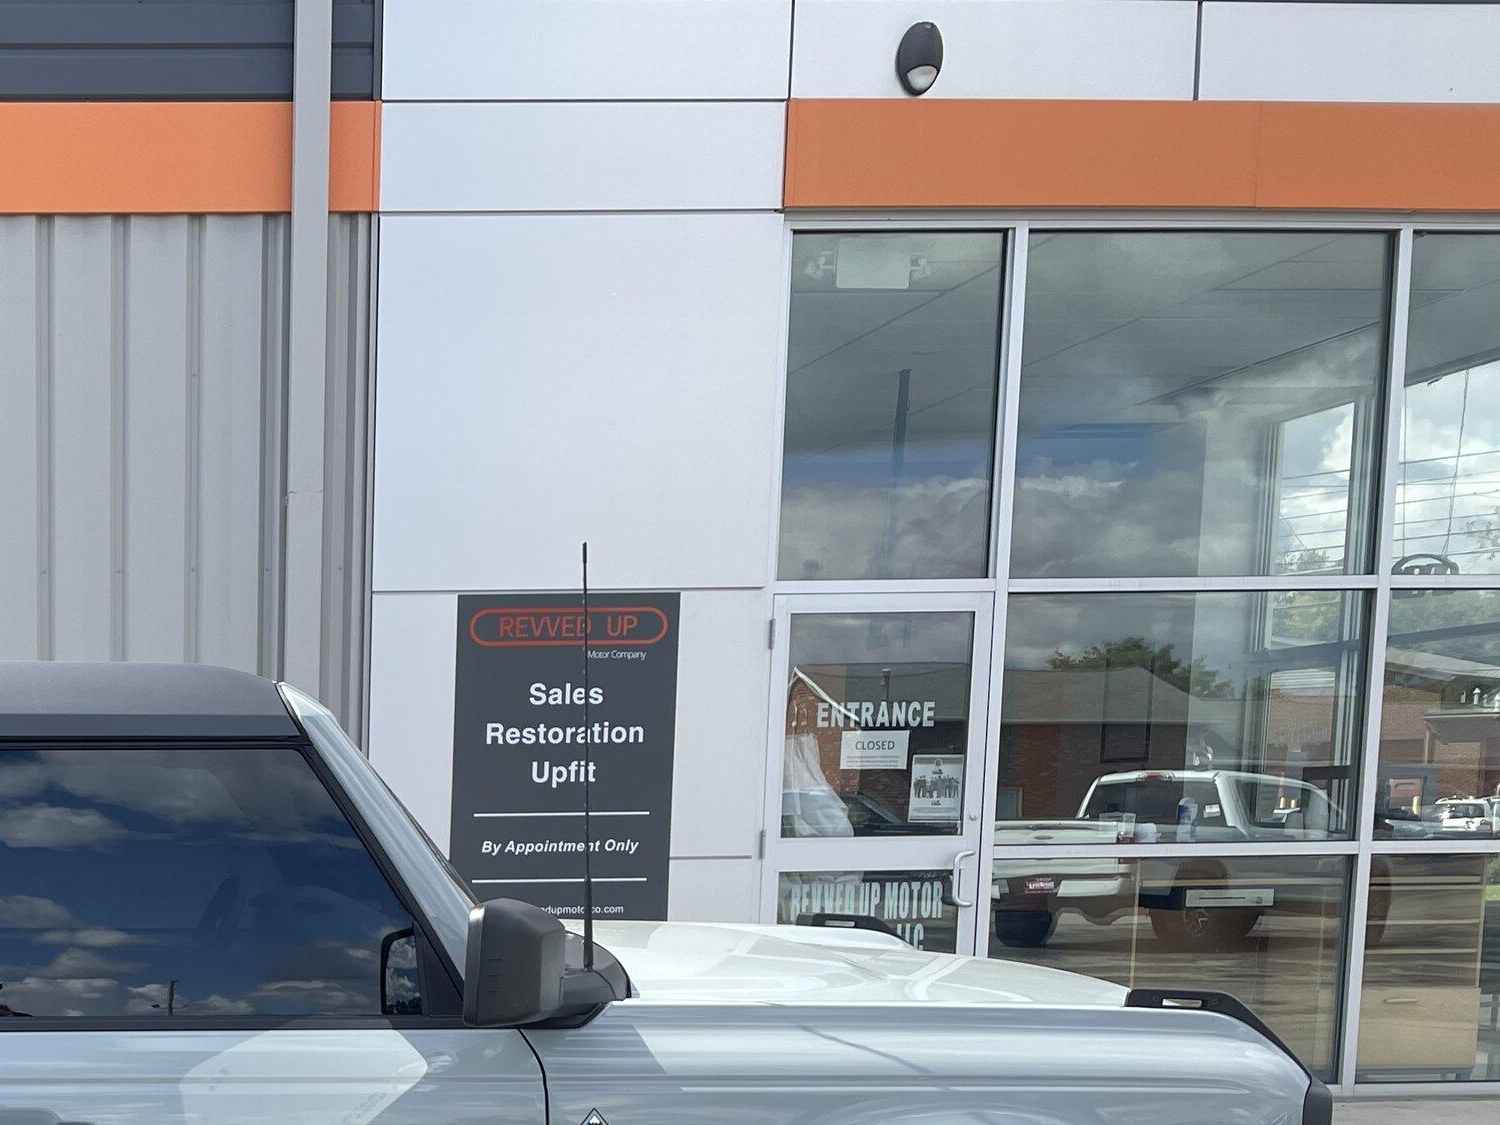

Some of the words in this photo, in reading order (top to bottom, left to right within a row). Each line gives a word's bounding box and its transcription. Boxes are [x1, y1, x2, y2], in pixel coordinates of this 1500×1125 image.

[499, 615, 592, 638] REVVED
[607, 614, 639, 637] UP
[587, 650, 610, 659] Motor
[611, 649, 646, 660] Company
[529, 683, 604, 705] Sales
[816, 701, 936, 728] ENTRANCE
[486, 721, 644, 745] Restoration
[855, 740, 895, 750] CLOSED
[531, 760, 596, 788] Upfit
[481, 840, 501, 856] By
[505, 840, 600, 855] Appointment
[604, 838, 639, 854] Only
[790, 882, 856, 921] REVVED
[858, 881, 881, 918] UP
[883, 881, 943, 919] MOTOR
